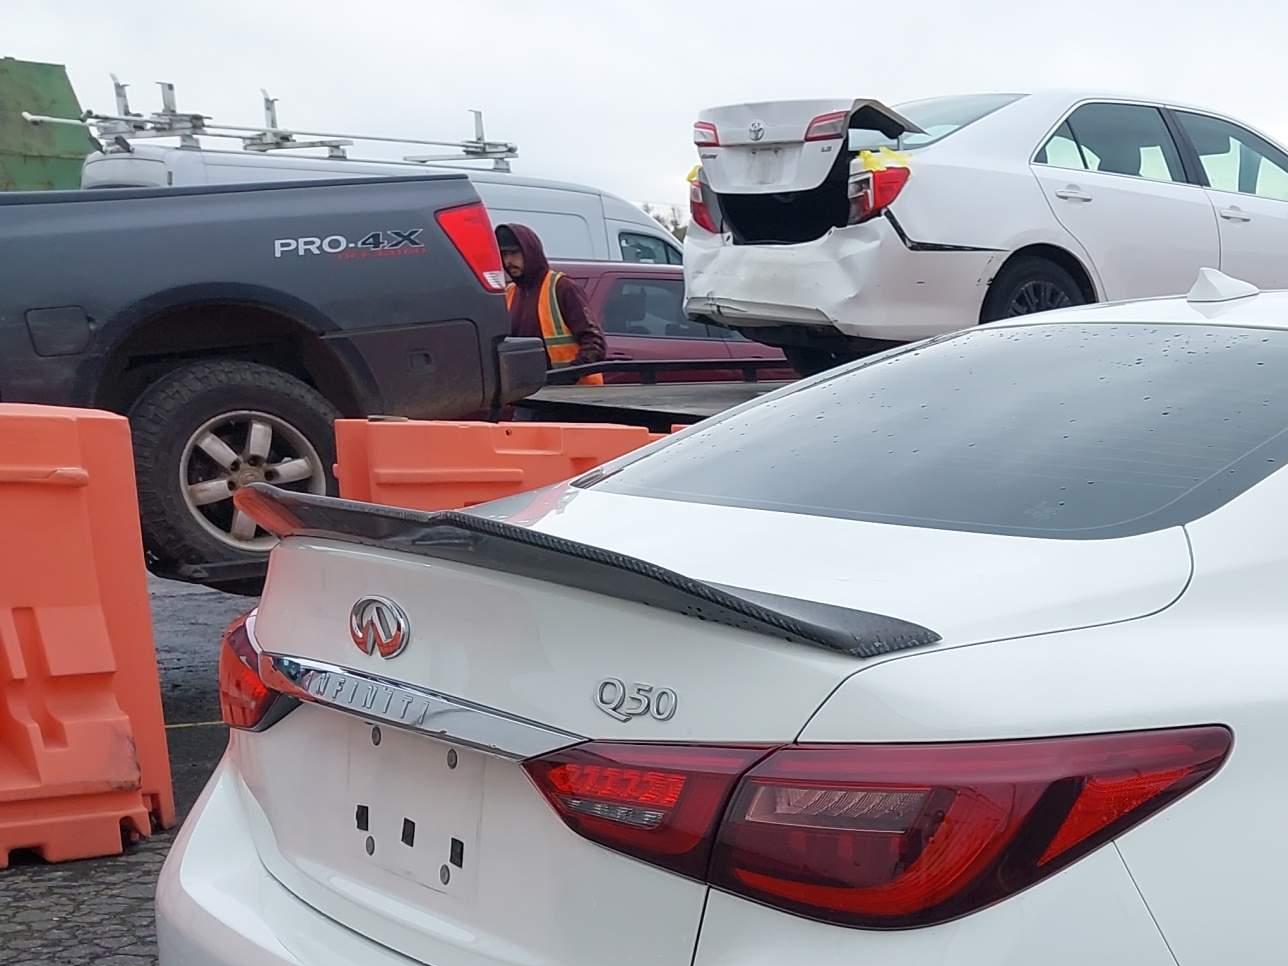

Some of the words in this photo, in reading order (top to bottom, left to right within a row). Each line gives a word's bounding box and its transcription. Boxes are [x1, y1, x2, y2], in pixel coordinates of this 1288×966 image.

[273, 228, 425, 258] PRO-4X
[302, 669, 431, 726] INFINITI
[592, 676, 679, 724] Q50
